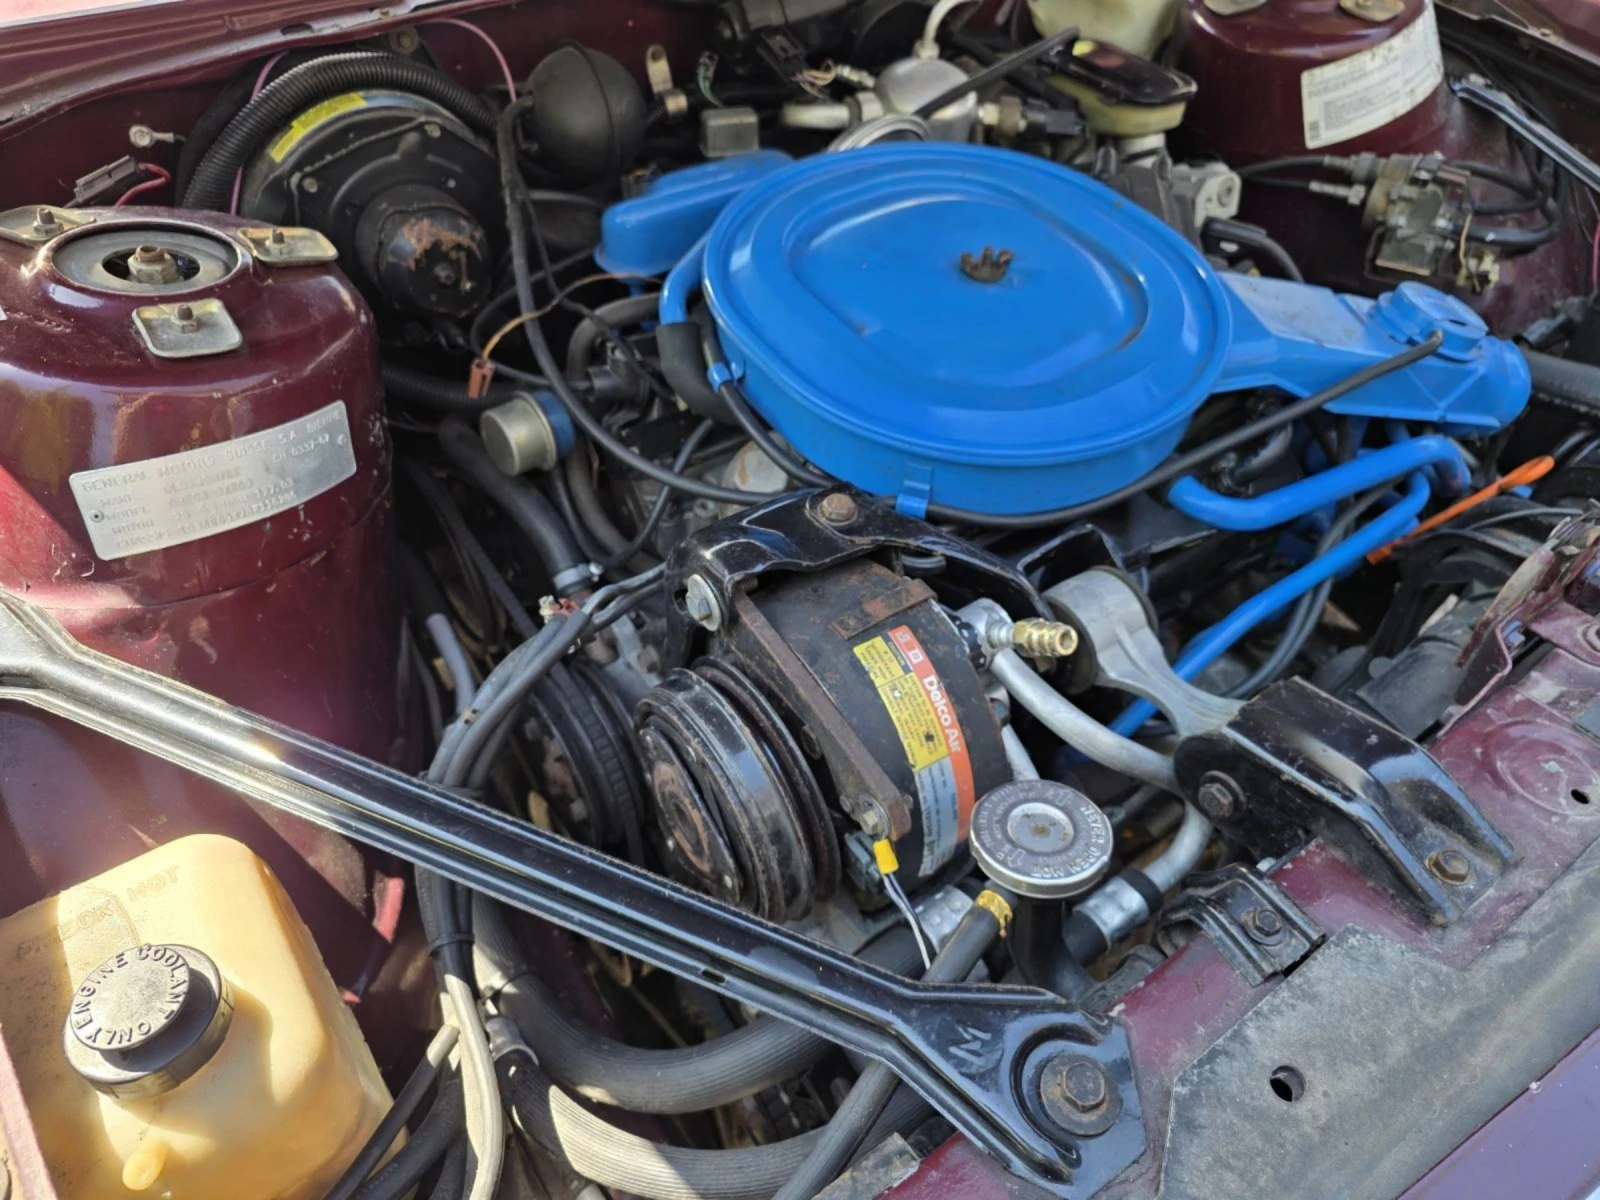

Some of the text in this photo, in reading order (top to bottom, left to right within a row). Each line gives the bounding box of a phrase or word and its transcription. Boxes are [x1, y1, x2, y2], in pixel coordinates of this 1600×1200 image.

[82, 470, 147, 493] GENERAL
[158, 455, 216, 479] MOTORS
[922, 675, 961, 753] Delco Air
[1030, 804, 1105, 878] NEVER OPEN HOT
[127, 864, 180, 902] HOT
[74, 942, 187, 1046] ENGINE COOLANT ONLY
